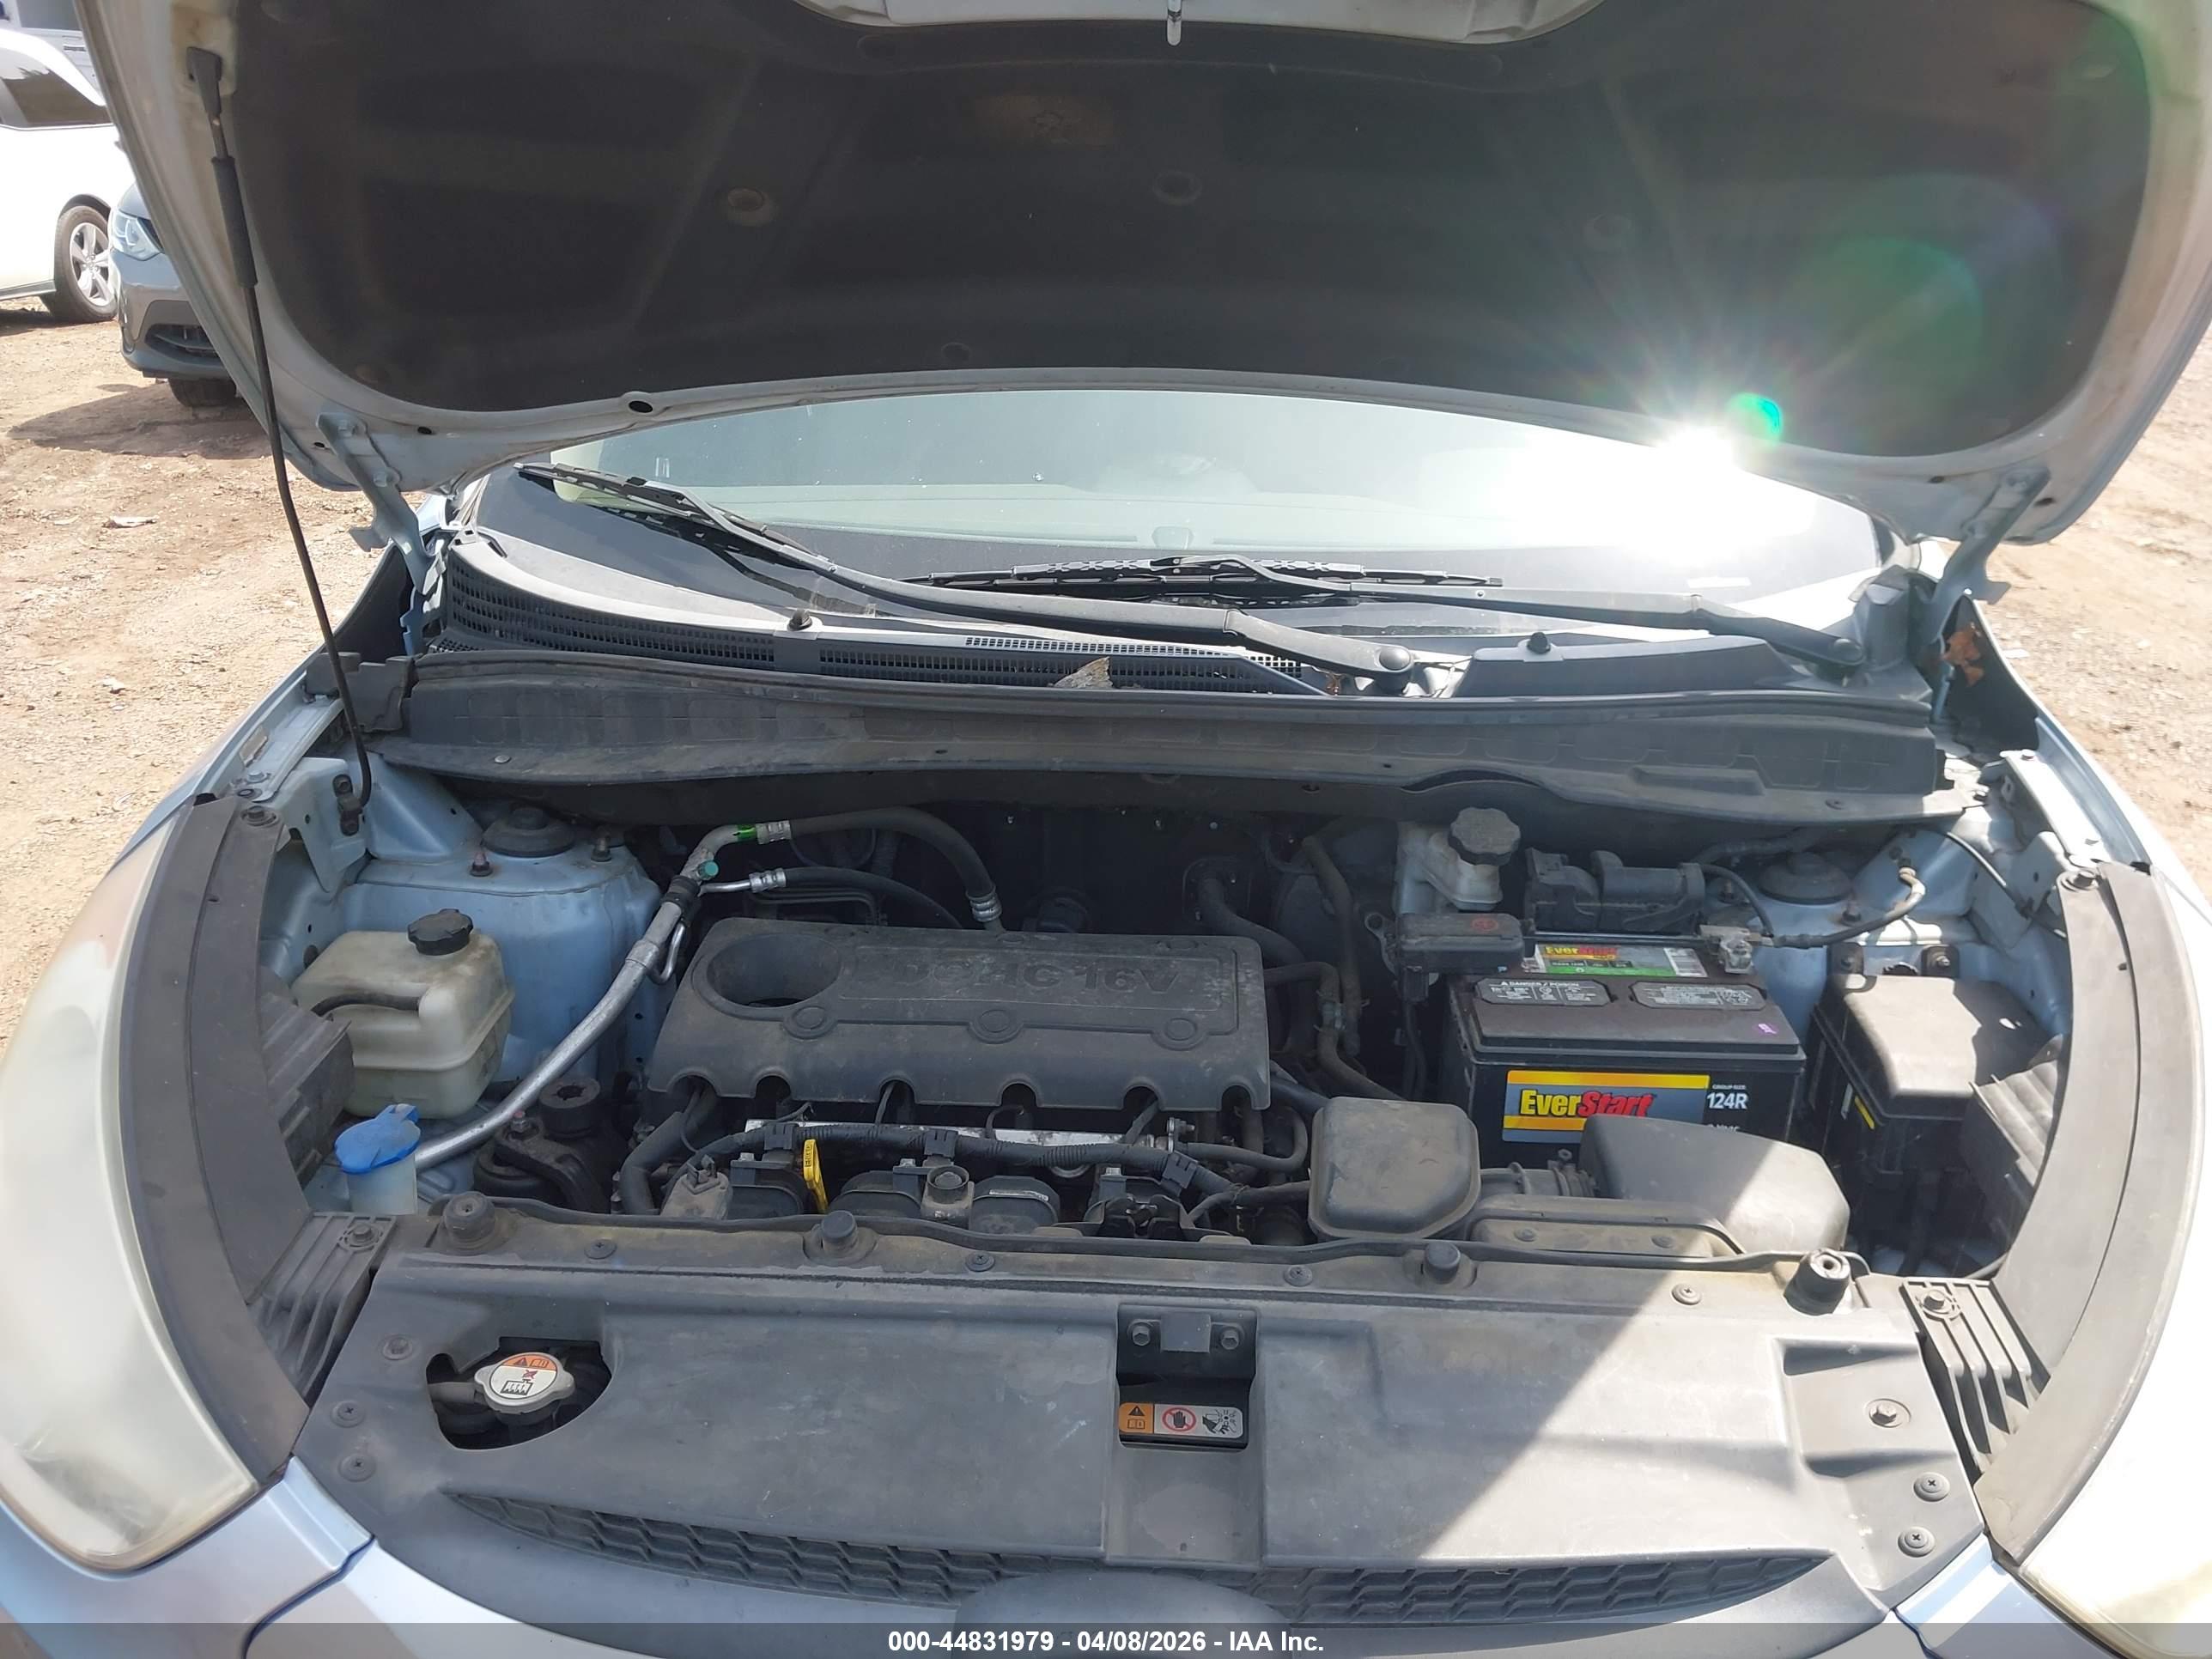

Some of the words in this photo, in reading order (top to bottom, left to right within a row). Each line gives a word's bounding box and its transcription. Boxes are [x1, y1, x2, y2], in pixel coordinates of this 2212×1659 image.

[1073, 960, 1181, 994] 16V
[1519, 1089, 1654, 1117] EverStart
[1706, 1091, 1749, 1109] 124R
